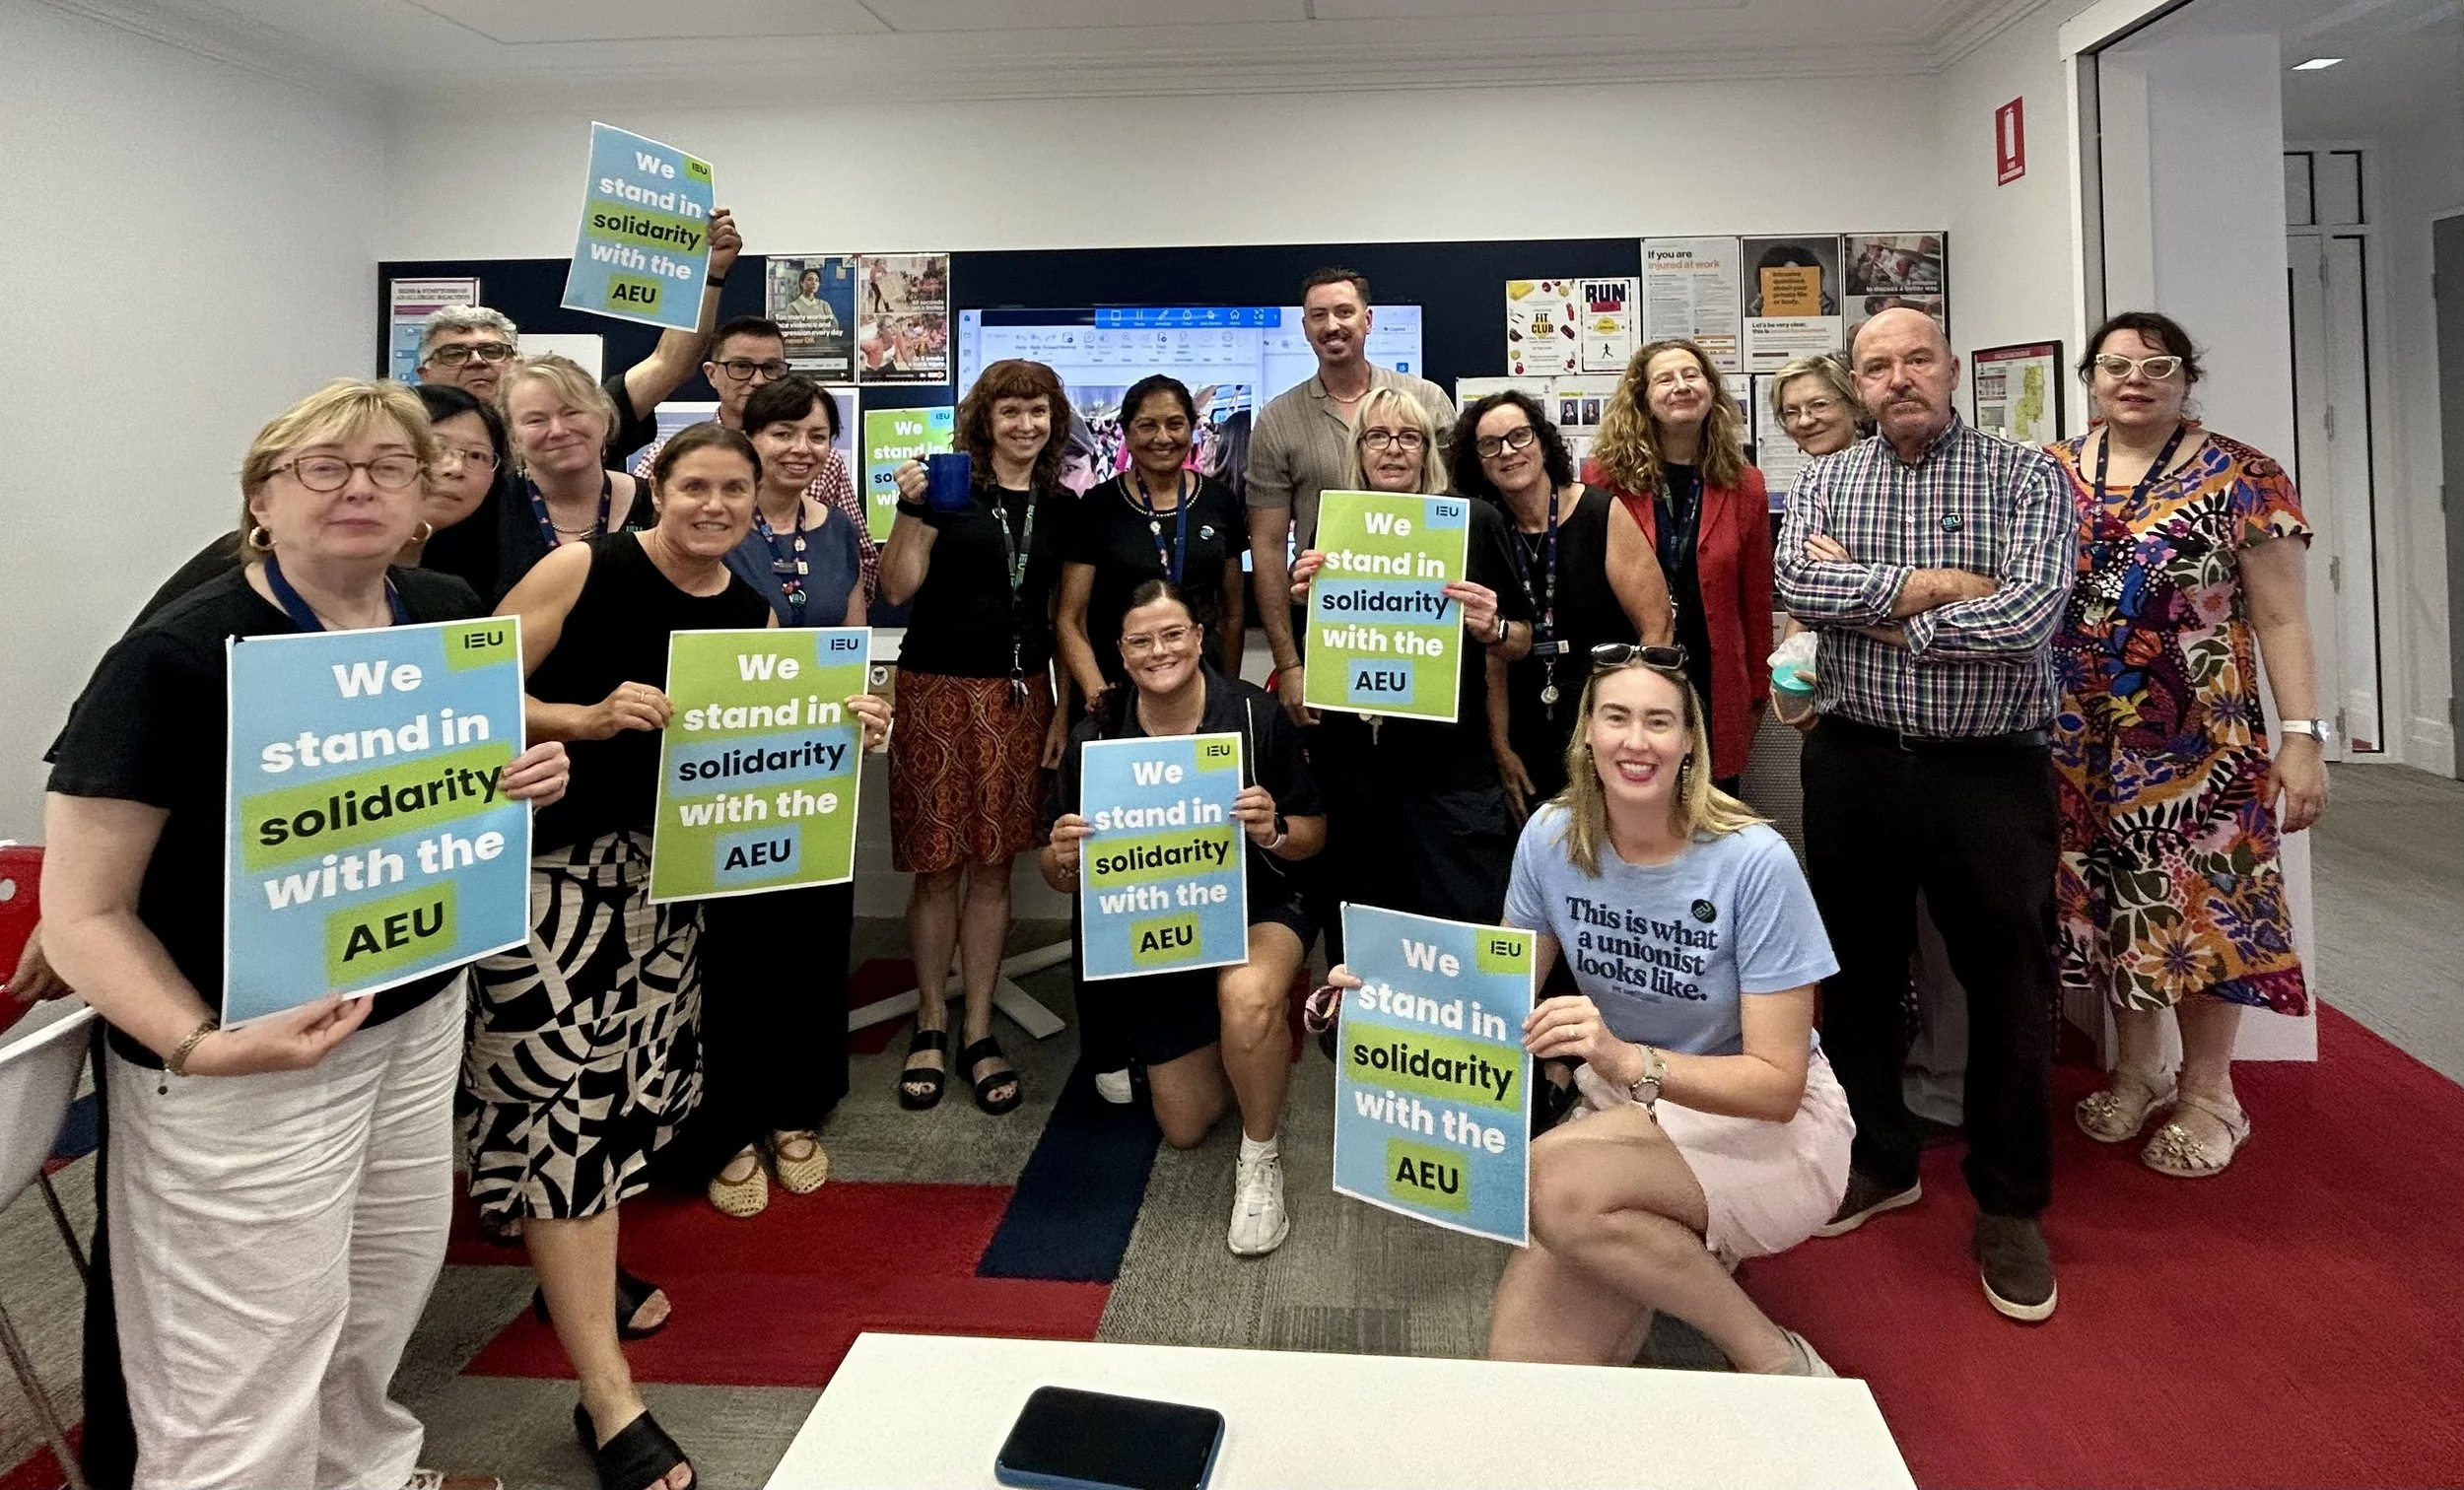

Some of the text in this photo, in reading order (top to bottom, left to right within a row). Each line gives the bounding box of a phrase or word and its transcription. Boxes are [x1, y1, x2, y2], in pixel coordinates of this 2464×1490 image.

[636, 151, 674, 178] We
[692, 163, 707, 175] IEU
[598, 177, 702, 219] stand in
[593, 214, 701, 250] solidarity
[591, 243, 692, 280] with the
[1648, 259, 1682, 270] injured
[1694, 259, 1720, 268] work
[1657, 251, 1674, 260] you
[611, 283, 656, 304] AEU
[1585, 284, 1625, 304] RUN
[1532, 323, 1553, 334] CLUB
[1536, 312, 1548, 323] FIT
[894, 421, 924, 436] We
[873, 442, 924, 460] stand
[876, 491, 901, 506] wi
[1436, 506, 1459, 517] IEU
[1364, 511, 1411, 536] We
[1324, 549, 1445, 578] stand in
[1322, 589, 1450, 620] solidarity
[464, 631, 503, 648] IEU
[831, 639, 858, 651] IEU
[1322, 624, 1444, 657] with the
[331, 660, 423, 699] We
[737, 653, 800, 681] We
[1354, 670, 1405, 692] AEU
[683, 695, 842, 731] stand in
[261, 708, 490, 774] stand in
[1206, 744, 1231, 757] IEU
[679, 741, 847, 782] solidarity
[1132, 761, 1184, 786] We
[259, 765, 504, 847] solidarity
[679, 789, 838, 828] with the
[1094, 797, 1222, 832] stand in
[263, 830, 505, 911] with the
[723, 838, 791, 871] AEU
[1095, 839, 1229, 876] solidarity
[1099, 882, 1228, 914] with the
[342, 901, 444, 963] AEU
[1139, 924, 1193, 953] AEU
[1566, 896, 1719, 951] This is what
[1402, 937, 1460, 979] We
[1490, 939, 1522, 958] IEU
[1578, 930, 1706, 977] a unionist
[1577, 949, 1647, 987] looks
[1651, 967, 1708, 1001] like.
[1357, 982, 1507, 1042] stand in
[1354, 1042, 1513, 1102] solidarity
[1354, 1090, 1506, 1154] with the
[1395, 1156, 1459, 1195] AEU
